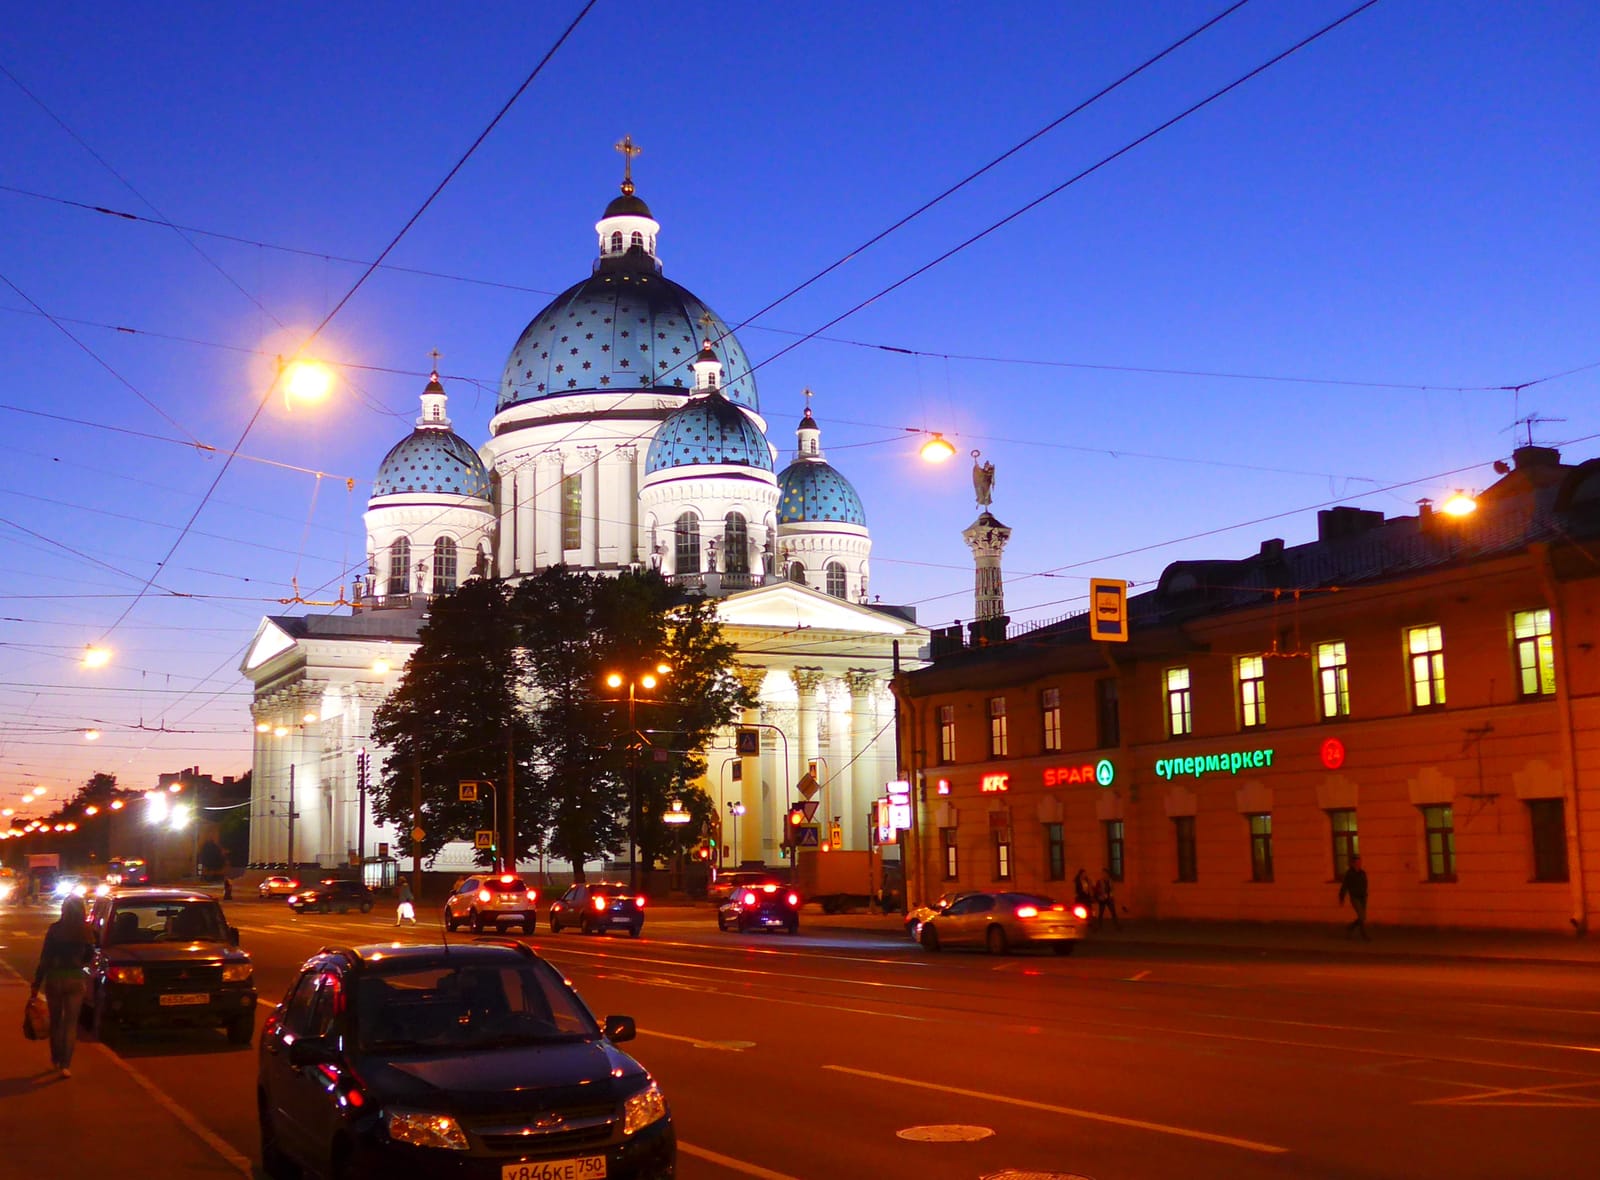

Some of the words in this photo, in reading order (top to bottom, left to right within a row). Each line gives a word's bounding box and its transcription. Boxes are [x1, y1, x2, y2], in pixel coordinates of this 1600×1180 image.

[1155, 749, 1274, 780] супермаркет
[982, 775, 1009, 792] KFC
[1043, 765, 1095, 786] SPAR
